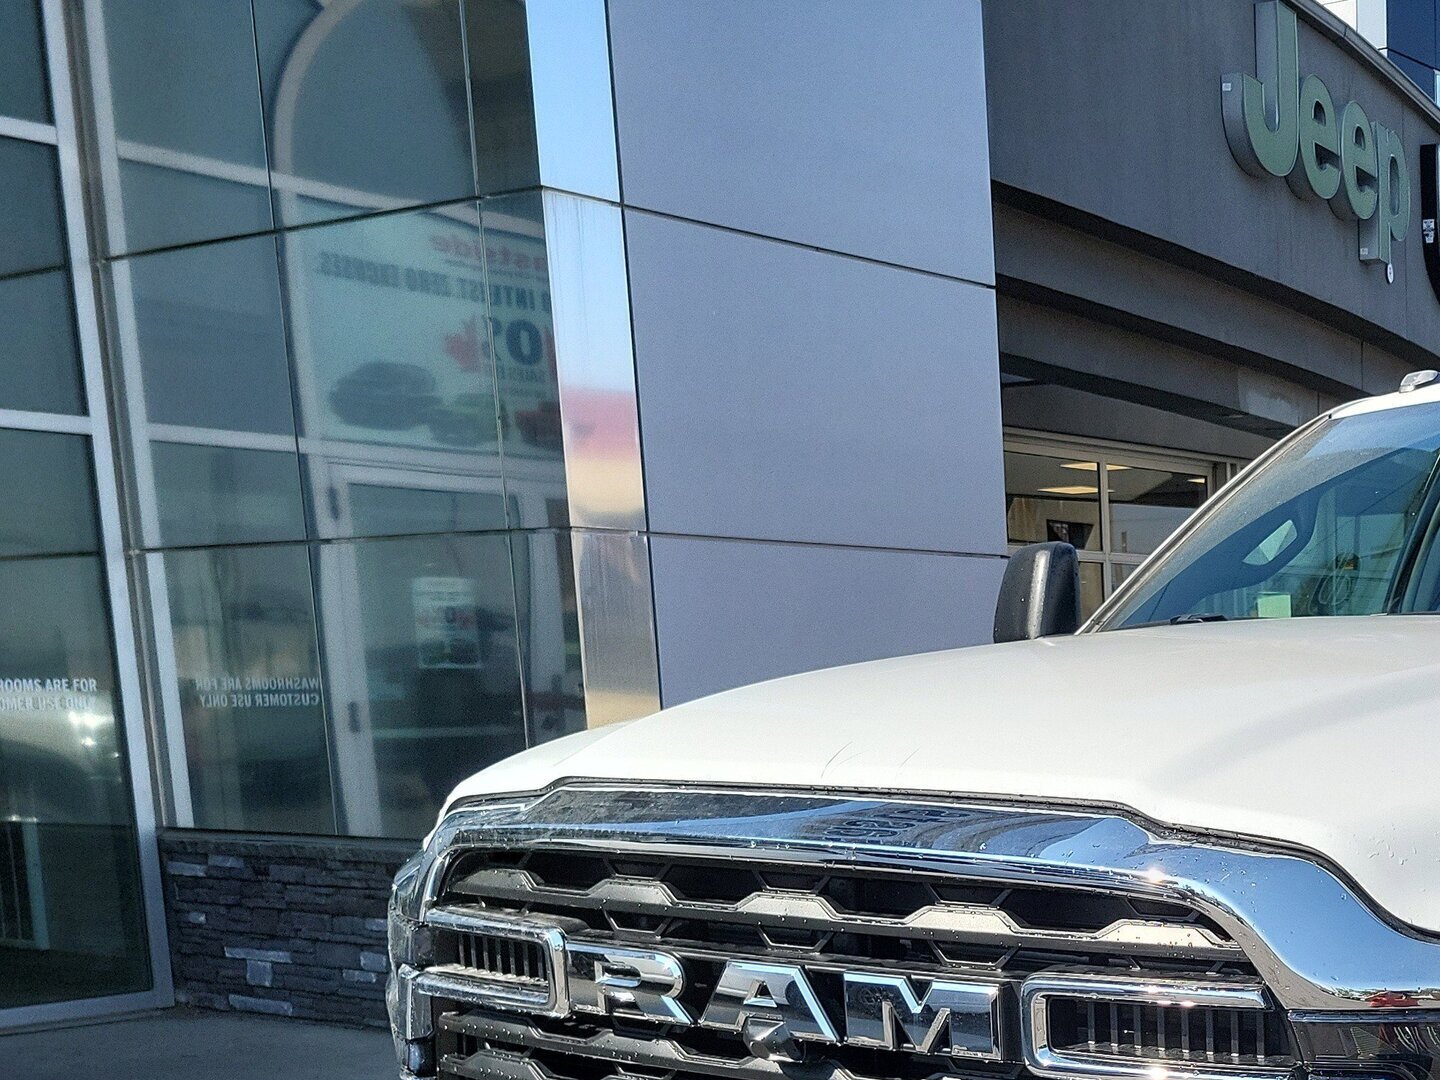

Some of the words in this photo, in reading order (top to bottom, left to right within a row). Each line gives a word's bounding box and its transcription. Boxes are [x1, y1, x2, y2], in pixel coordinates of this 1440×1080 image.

[1219, 0, 1411, 263] Jeep
[44, 678, 70, 692] ARE
[72, 678, 97, 692] FOR
[566, 942, 1002, 1062] RAM
